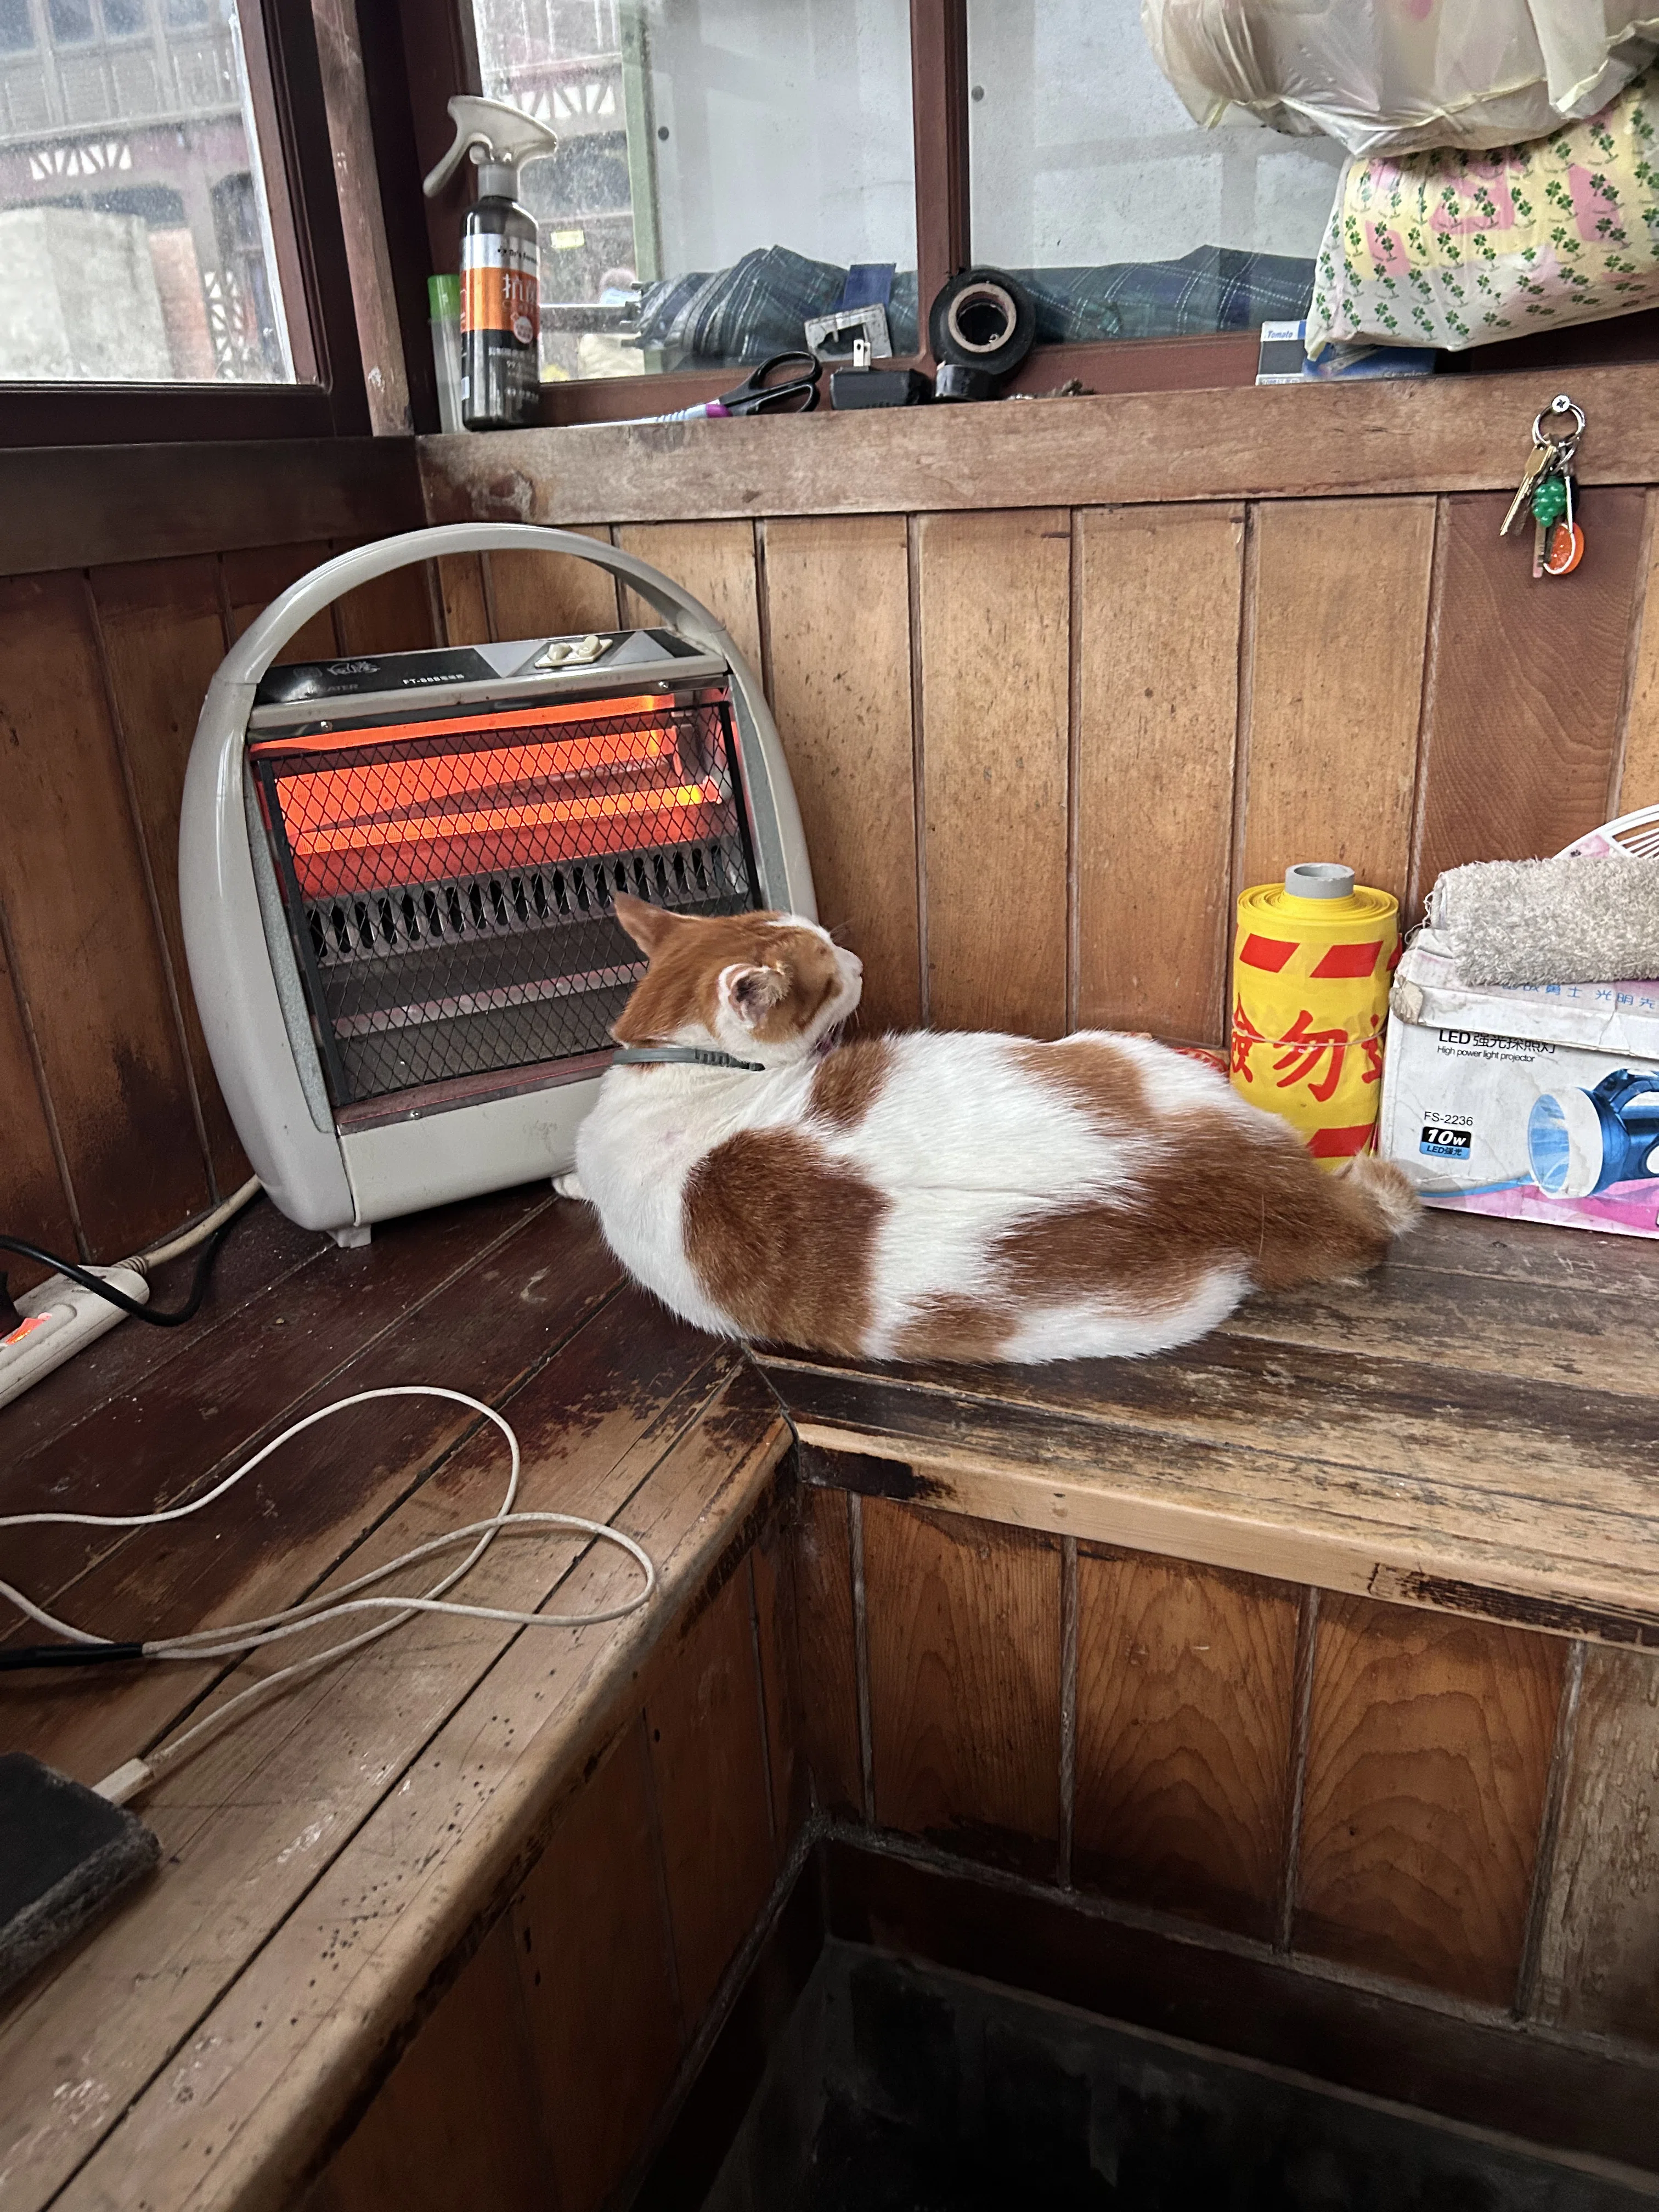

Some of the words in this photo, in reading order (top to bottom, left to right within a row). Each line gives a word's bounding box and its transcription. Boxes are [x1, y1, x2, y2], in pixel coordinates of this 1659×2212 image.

[1267, 330, 1293, 338] Tomato
[1438, 1030, 1471, 1045] LED
[1437, 1046, 1455, 1056] High
[1457, 1049, 1482, 1058] power
[1483, 1049, 1499, 1060] light
[1500, 1053, 1535, 1063] projector
[1424, 1111, 1474, 1126] FS-2236
